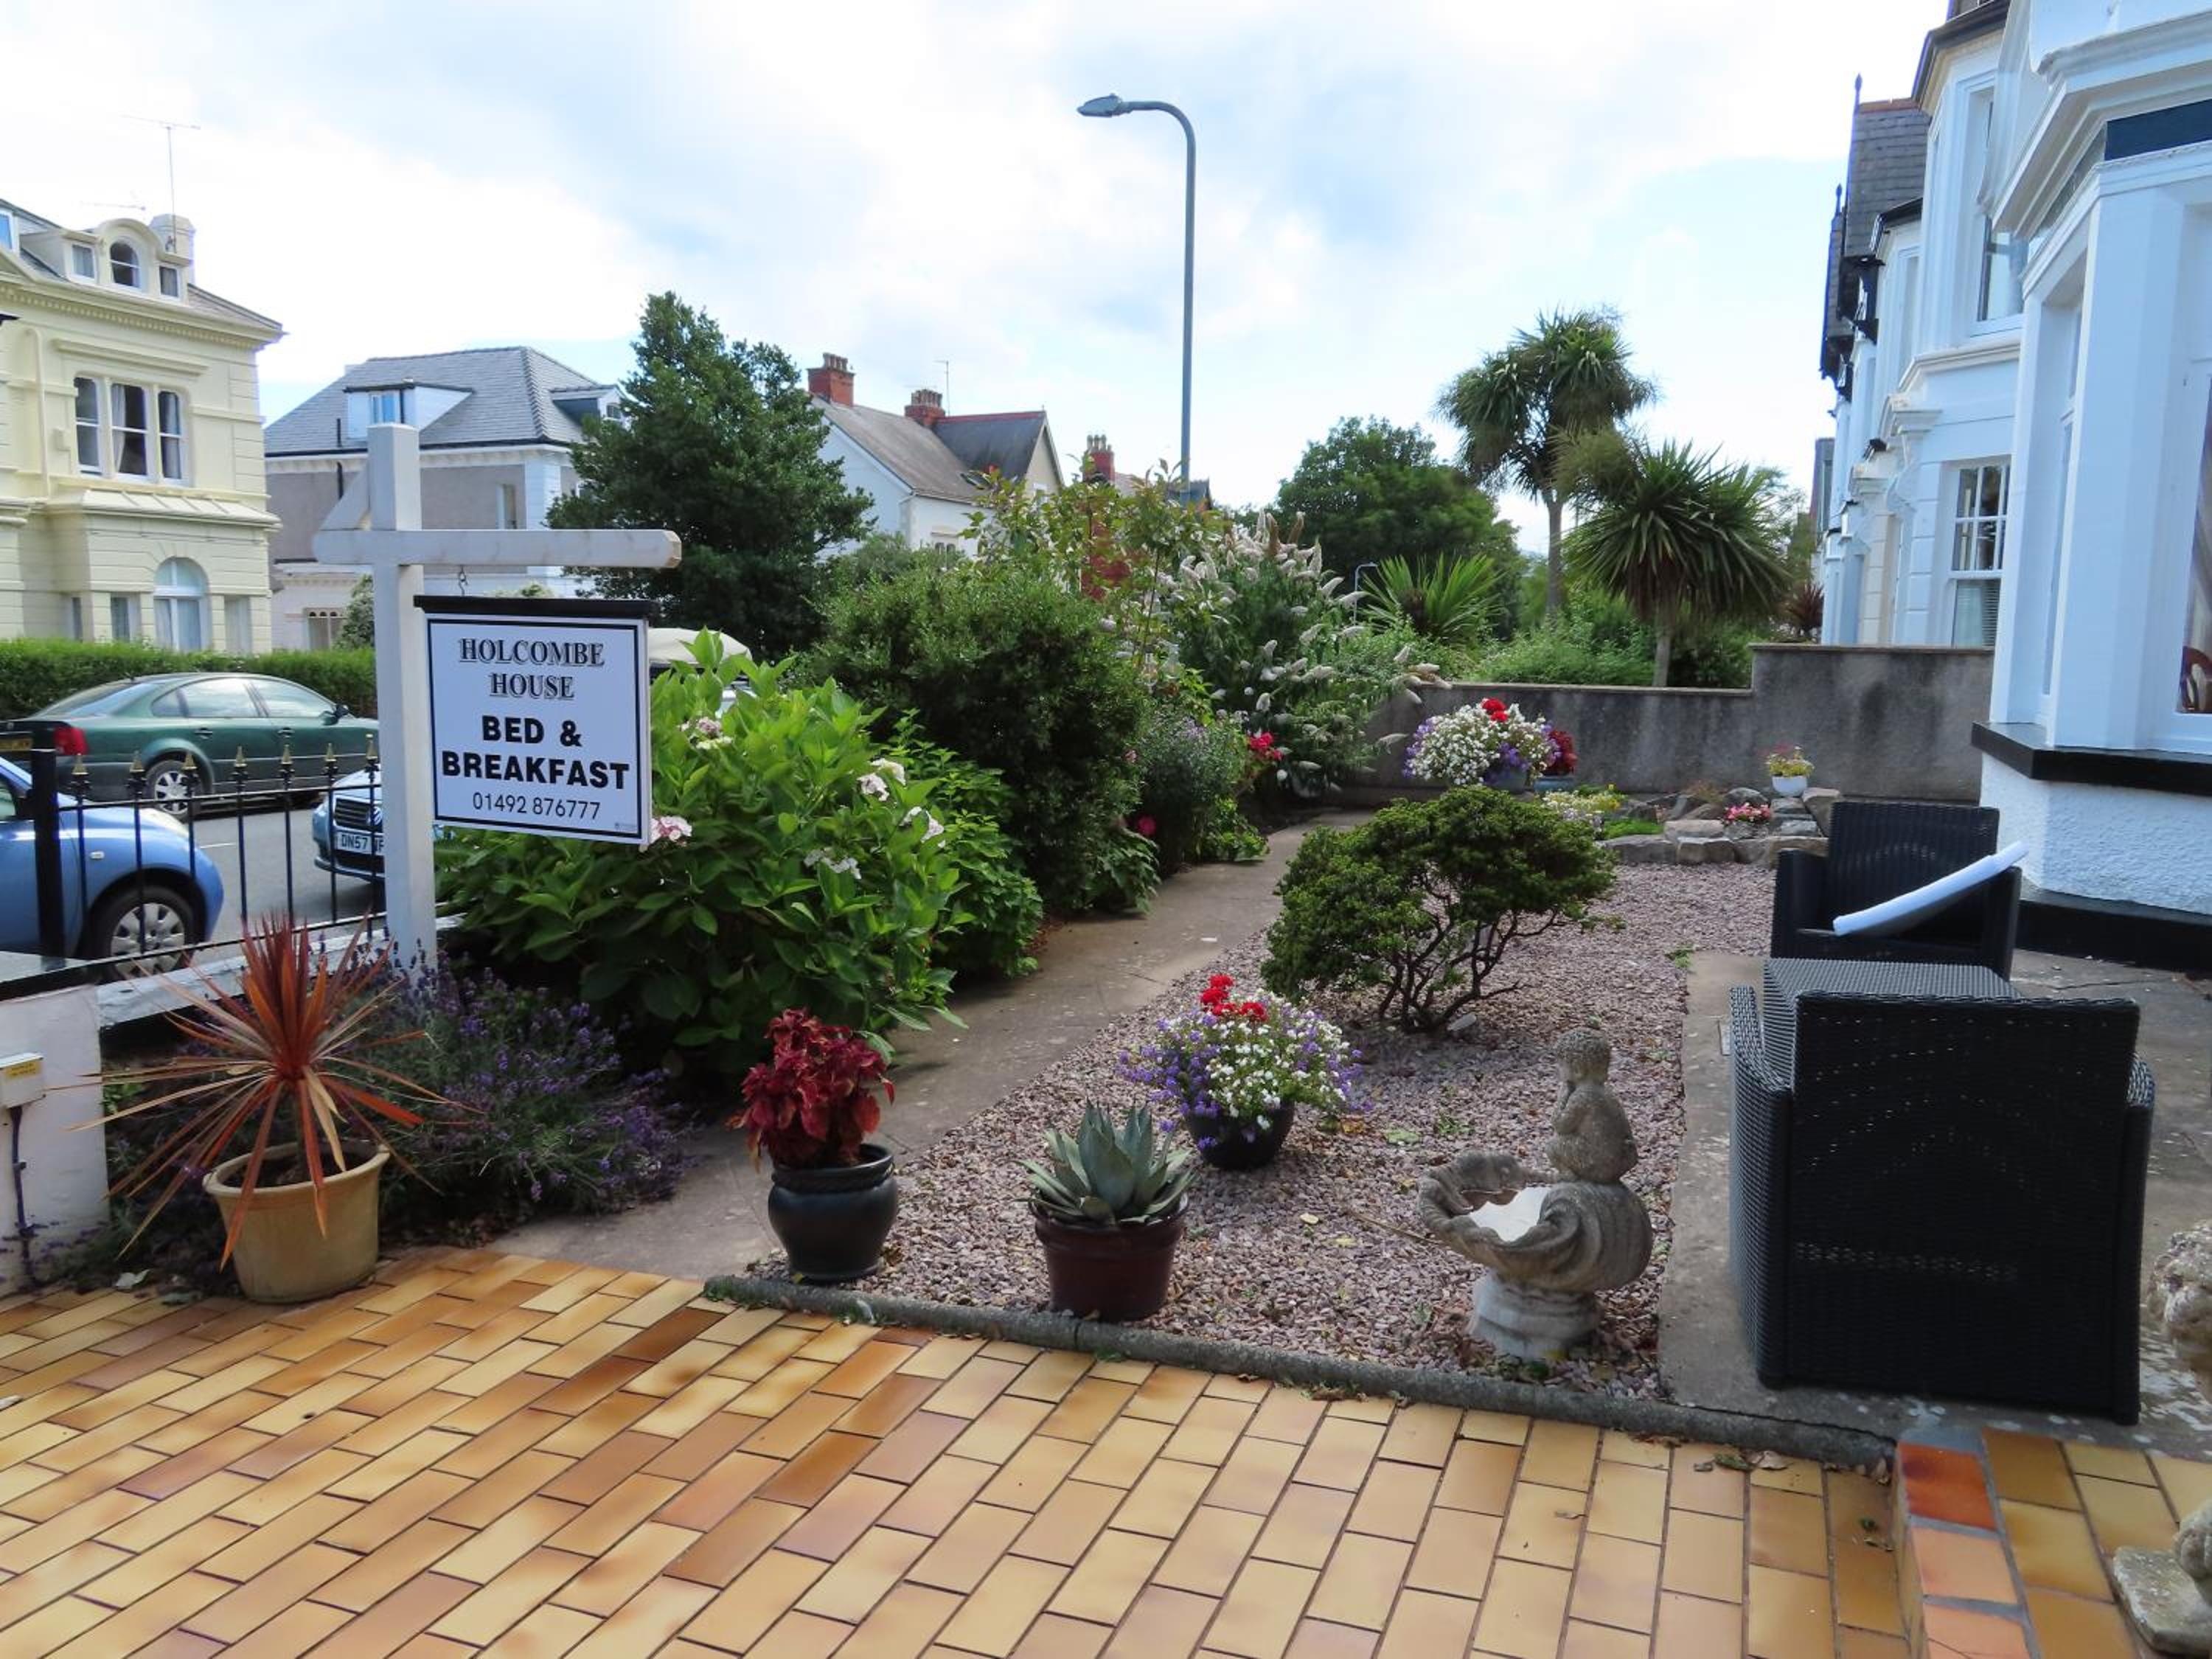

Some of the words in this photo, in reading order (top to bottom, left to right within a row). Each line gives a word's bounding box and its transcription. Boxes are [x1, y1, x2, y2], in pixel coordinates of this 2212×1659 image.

[459, 639, 604, 666] HOLCOMBE
[490, 673, 574, 700] HOUSE
[482, 715, 545, 745] BED
[560, 720, 582, 748] &
[442, 751, 630, 790] BREAKFAST
[473, 792, 527, 814] 01492
[532, 798, 601, 820] 876777
